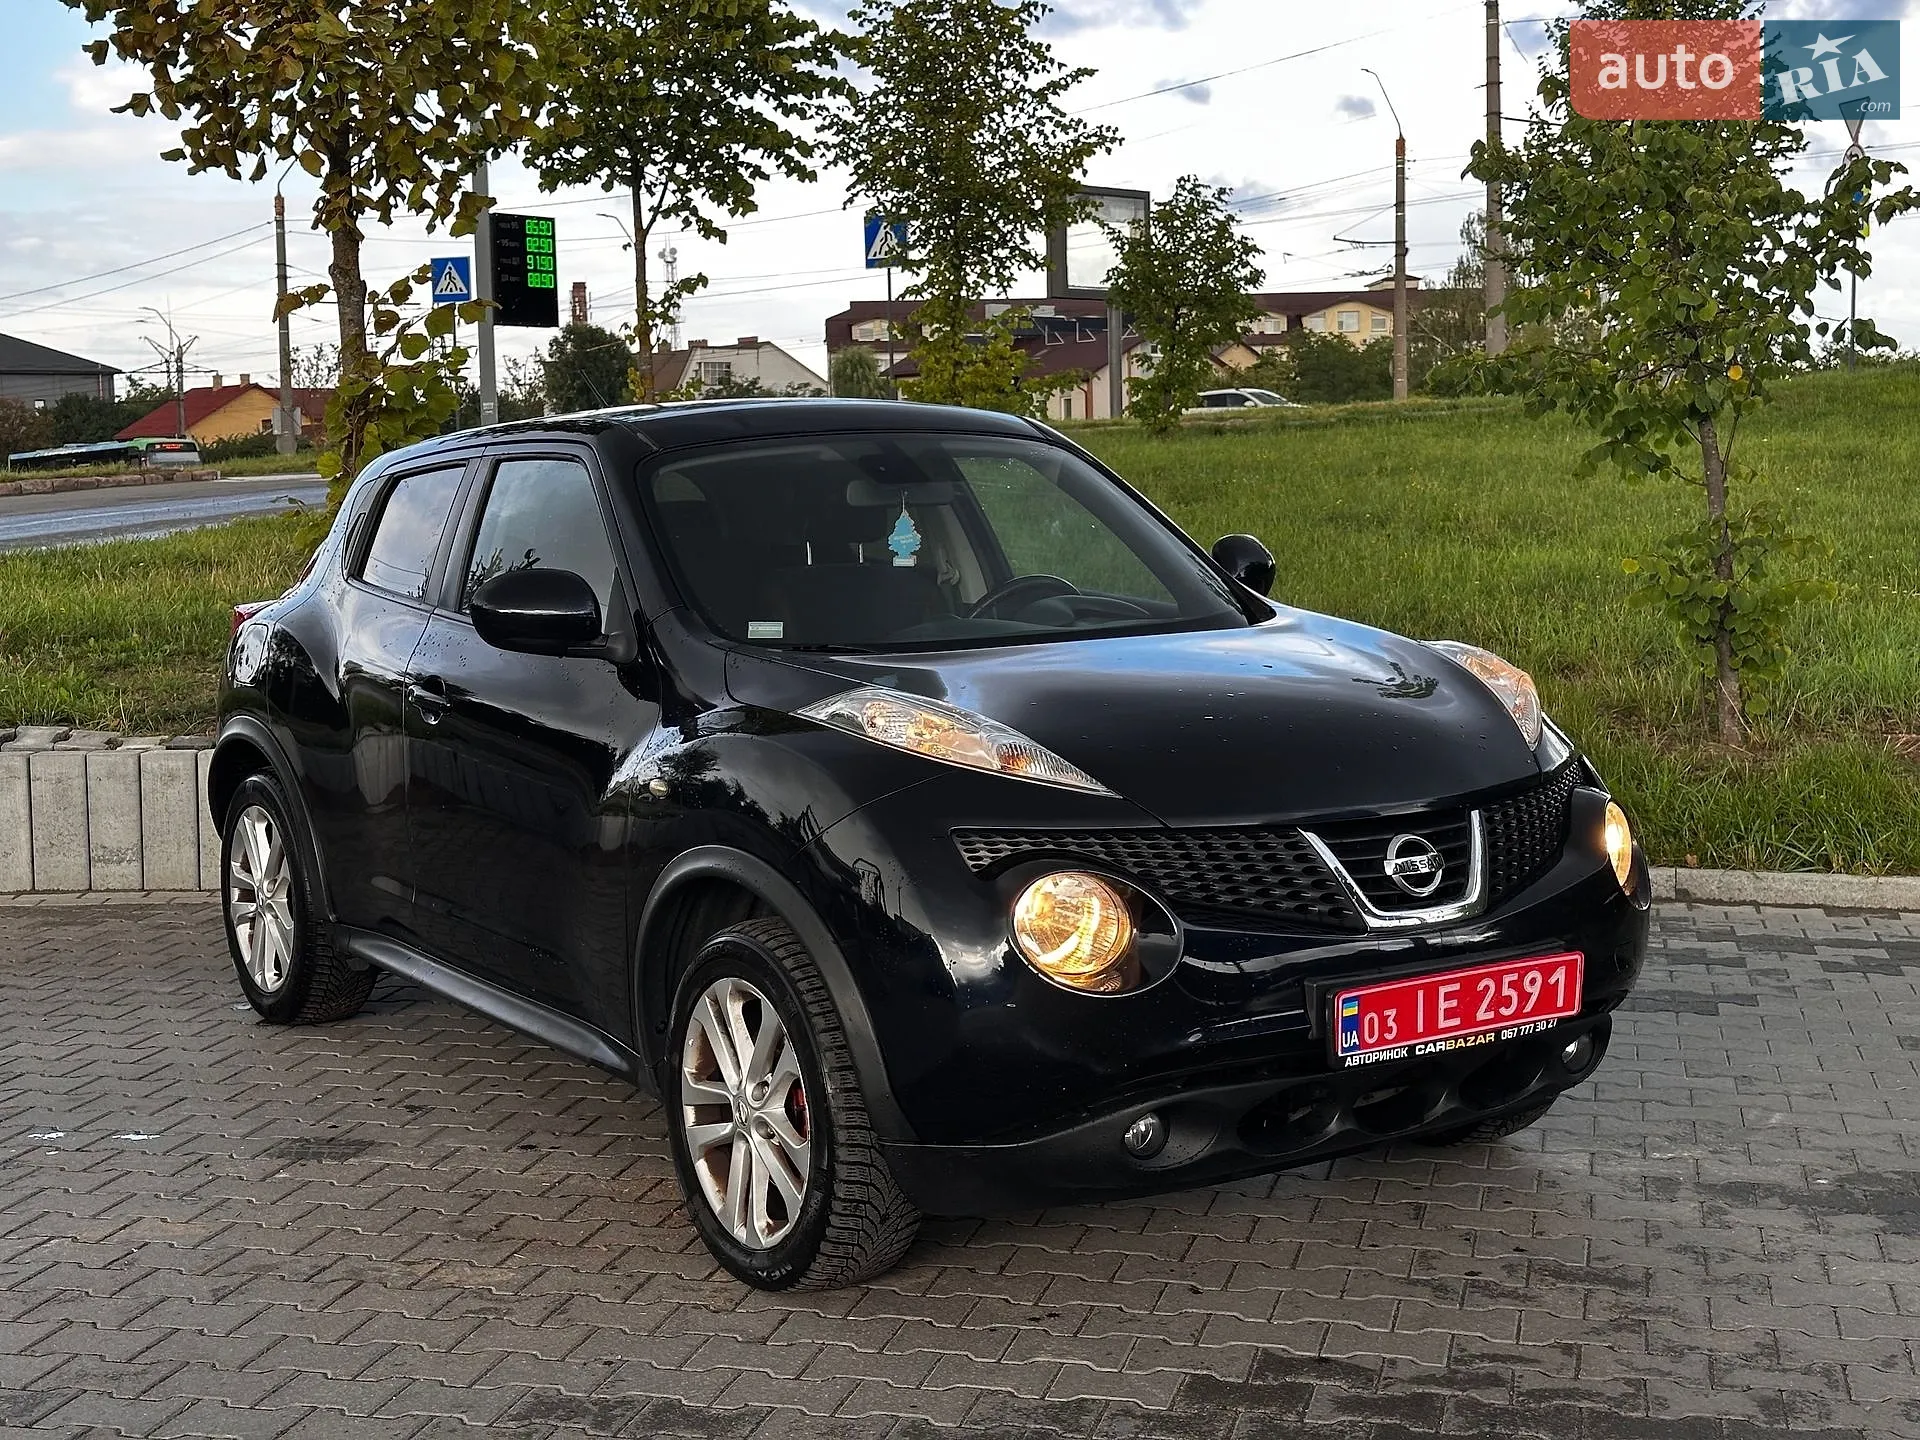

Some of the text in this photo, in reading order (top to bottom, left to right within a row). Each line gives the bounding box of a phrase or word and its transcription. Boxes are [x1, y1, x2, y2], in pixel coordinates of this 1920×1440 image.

[1393, 854, 1442, 874] NISSAN
[1363, 965, 1566, 1044] 03 IE 2591
[1342, 1030, 1360, 1048] UA
[1344, 1018, 1559, 1068] АВТОРИНОК CARBAZAR 067 777 30 27
